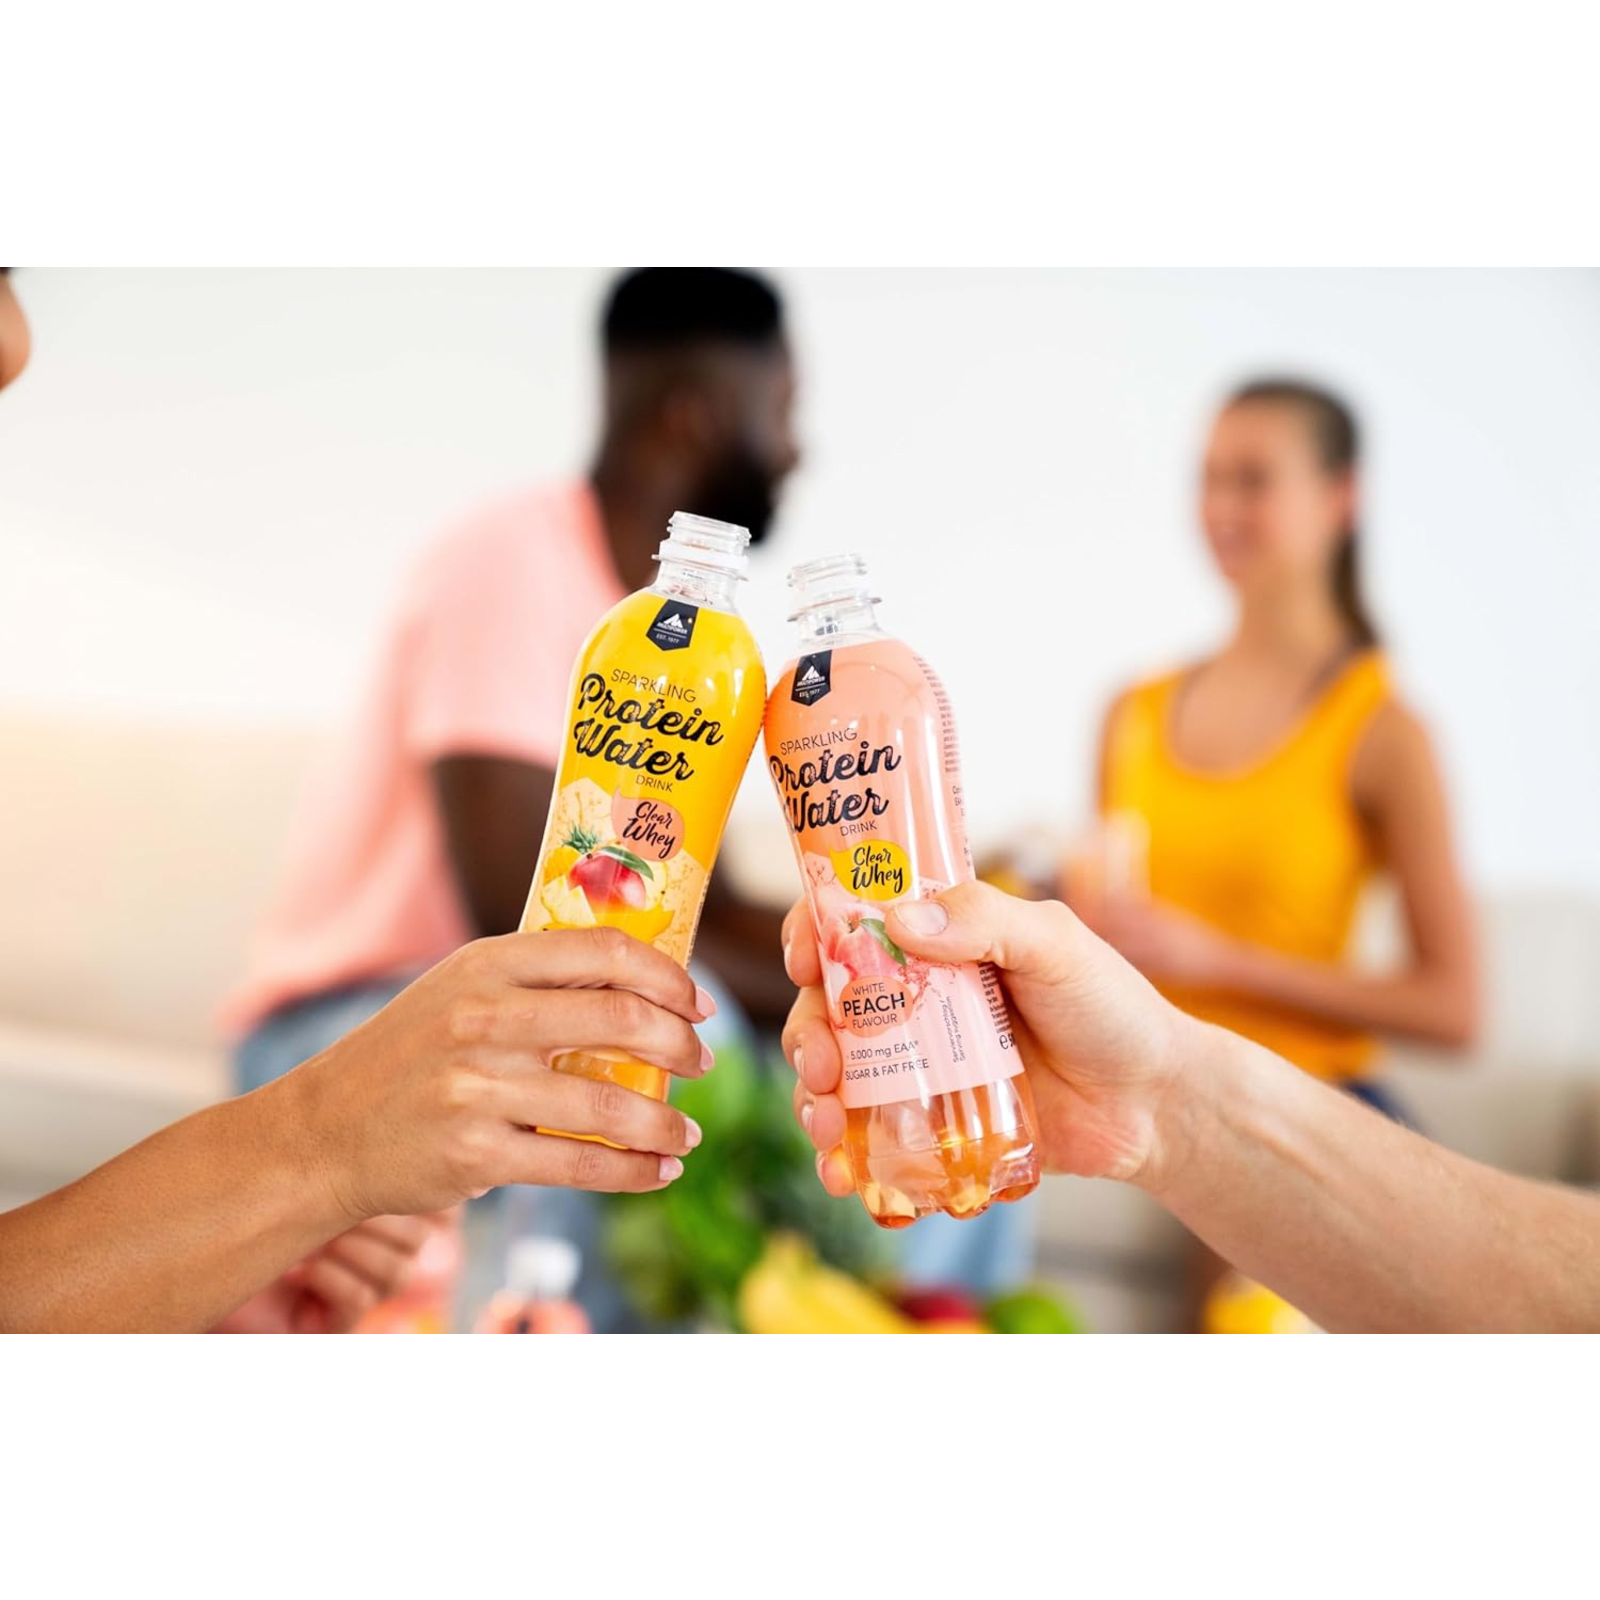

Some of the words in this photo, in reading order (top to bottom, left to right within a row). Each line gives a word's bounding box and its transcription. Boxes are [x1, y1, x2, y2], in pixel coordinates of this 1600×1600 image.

[610, 668, 697, 703] SPARKLING
[578, 673, 724, 746] Protein
[573, 718, 695, 781] Water
[780, 727, 858, 756] SPARKLING
[769, 741, 902, 795] Protein
[635, 774, 674, 793] DRINK
[635, 801, 673, 829] Clear
[840, 820, 878, 837] DRINK
[622, 817, 676, 859] Whey
[853, 845, 892, 867] Clear
[850, 863, 903, 894] Whey
[852, 982, 885, 996] WHITE
[843, 991, 906, 1018] PEACH
[852, 1013, 898, 1029] FLAVOUR
[875, 1046, 892, 1057] mg
[845, 1067, 871, 1081] SUGAR
[872, 1066, 880, 1077] &
[882, 1064, 900, 1076] FAT
[902, 1058, 929, 1071] FREE
